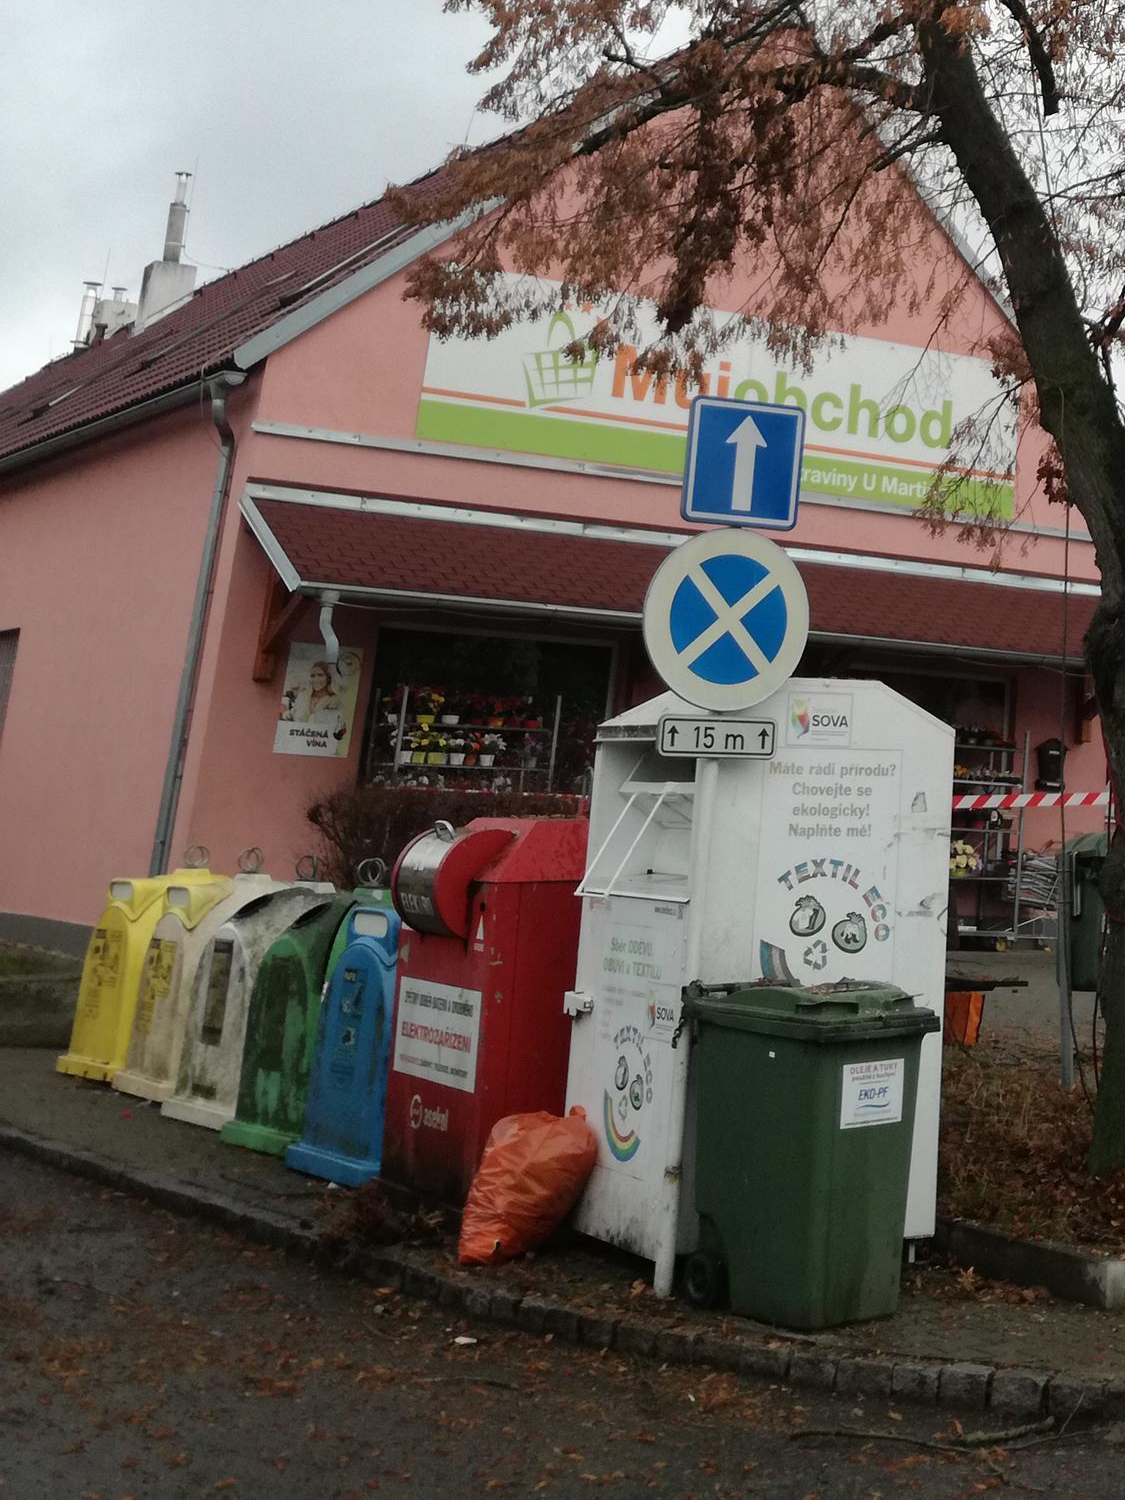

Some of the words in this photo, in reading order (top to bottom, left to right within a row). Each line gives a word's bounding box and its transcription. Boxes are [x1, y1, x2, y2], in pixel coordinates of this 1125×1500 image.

[863, 472, 877, 491] U
[881, 475, 929, 499] Marti
[812, 714, 848, 728] SOVA
[289, 728, 328, 739] STÁČENÁ
[694, 726, 715, 749] 15
[724, 732, 744, 750] m
[306, 739, 327, 748] VÍNA
[792, 782, 851, 798] Chovejte
[857, 786, 872, 796] se
[792, 803, 870, 819] ekologicky!
[788, 823, 841, 839] Naplňte
[777, 858, 861, 891] TEXTIL
[862, 885, 890, 942] ECO
[656, 1007, 674, 1021] SOVA
